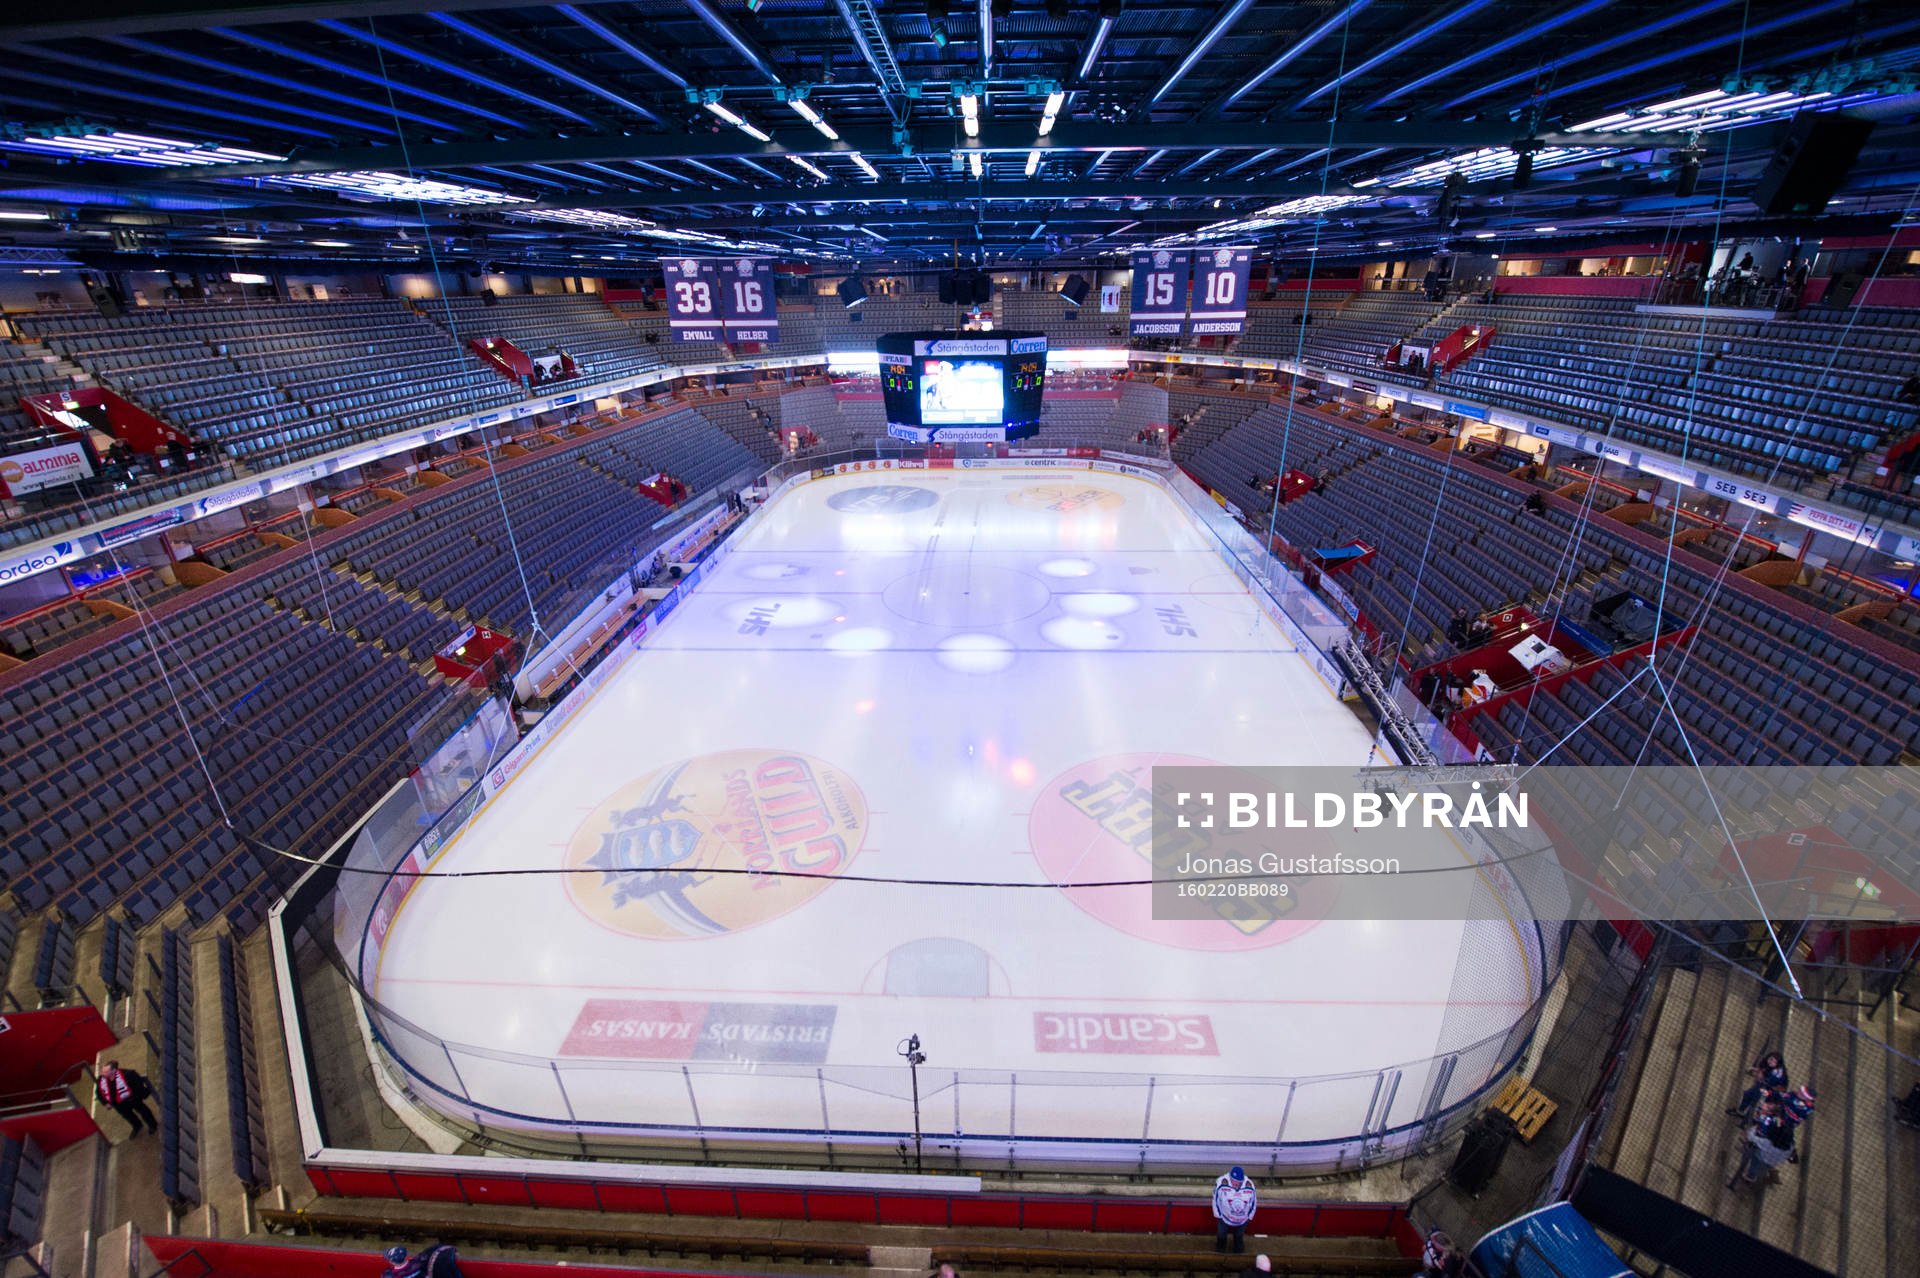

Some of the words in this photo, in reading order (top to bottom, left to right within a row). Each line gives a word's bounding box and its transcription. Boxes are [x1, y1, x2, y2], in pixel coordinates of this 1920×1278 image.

[675, 282, 712, 313] 33
[734, 281, 763, 313] 16
[1145, 273, 1175, 305] 15
[1205, 272, 1236, 304] 10
[682, 331, 715, 340] EMVALL
[737, 331, 769, 340] HELBER
[1134, 324, 1181, 334] JACOBSSON
[1193, 322, 1241, 333] ANDERSSON
[936, 340, 1001, 354] Stångåstaden
[1011, 339, 1047, 354] Corren
[889, 424, 918, 441] Corren
[939, 428, 999, 441] Stångåstaden
[1603, 446, 1619, 456] SAAB
[1030, 459, 1057, 467] centric
[208, 486, 260, 507] Stångåstaden
[1714, 481, 1737, 495] SEB
[1743, 490, 1767, 504] SEB
[737, 603, 781, 636] SHL
[1154, 604, 1199, 638] SHL
[822, 769, 860, 830] ALKOHOLFRI
[752, 756, 848, 879] GULD
[722, 768, 781, 891] NORRLANDS
[588, 1019, 692, 1041] KANSAS
[707, 1022, 829, 1044] FRISTADS
[1046, 1014, 1206, 1048] Scandic
